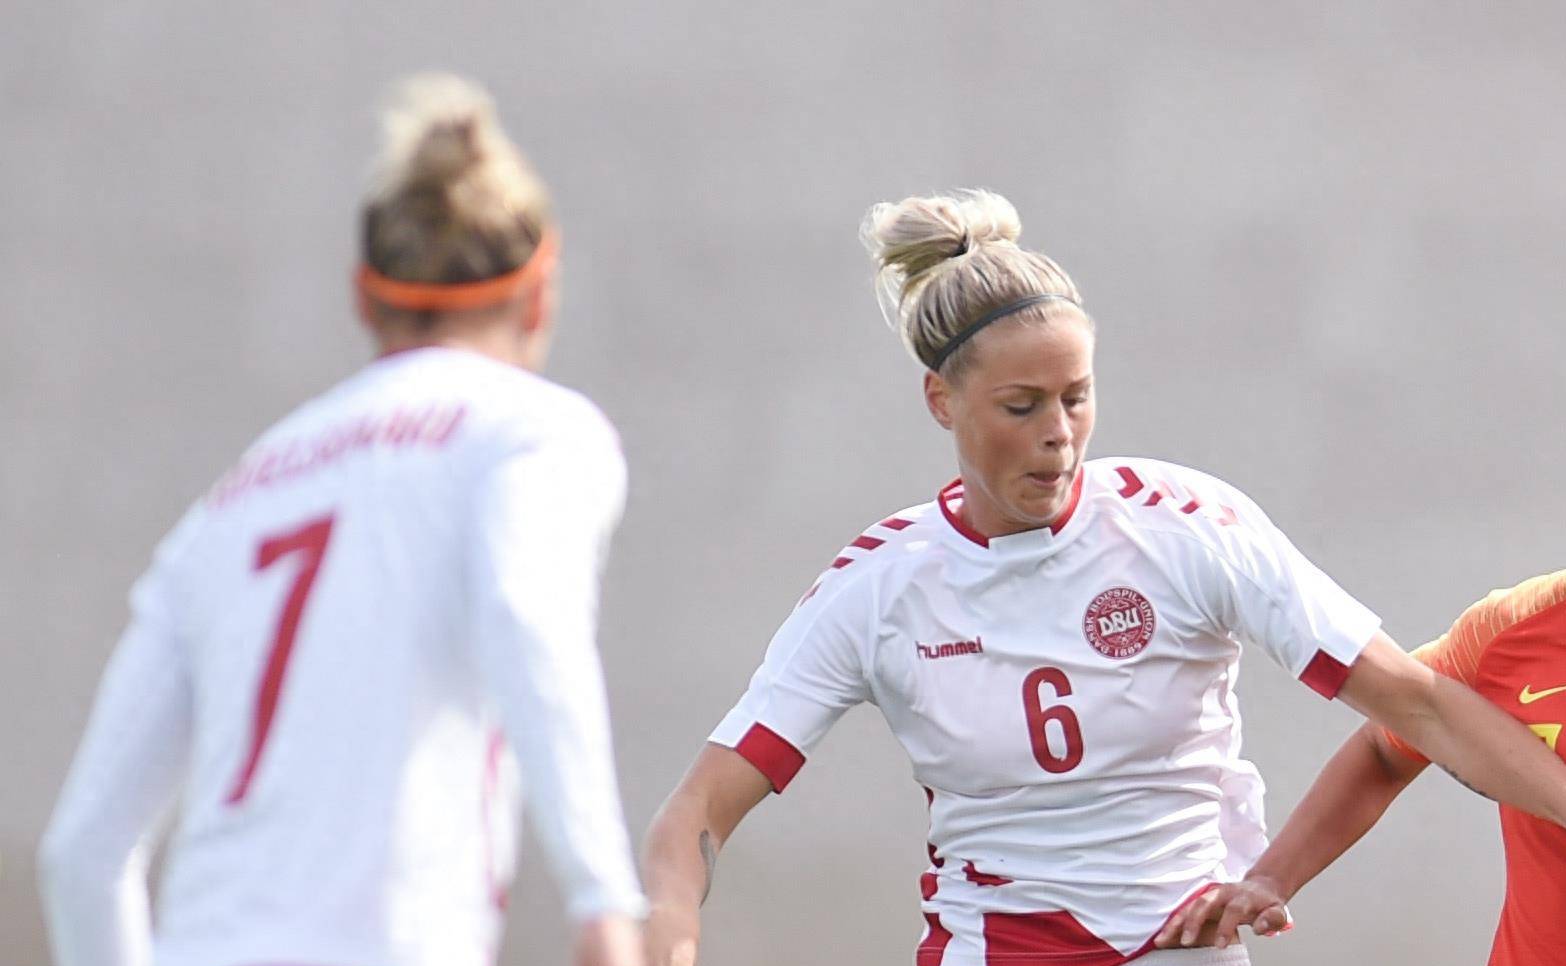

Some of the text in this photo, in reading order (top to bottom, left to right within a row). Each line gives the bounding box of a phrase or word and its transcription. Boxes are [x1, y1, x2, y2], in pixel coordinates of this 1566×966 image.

[222, 505, 340, 806] 7
[915, 635, 984, 660] hummel
[1098, 607, 1142, 637] DBU
[1021, 666, 1085, 774] 6
